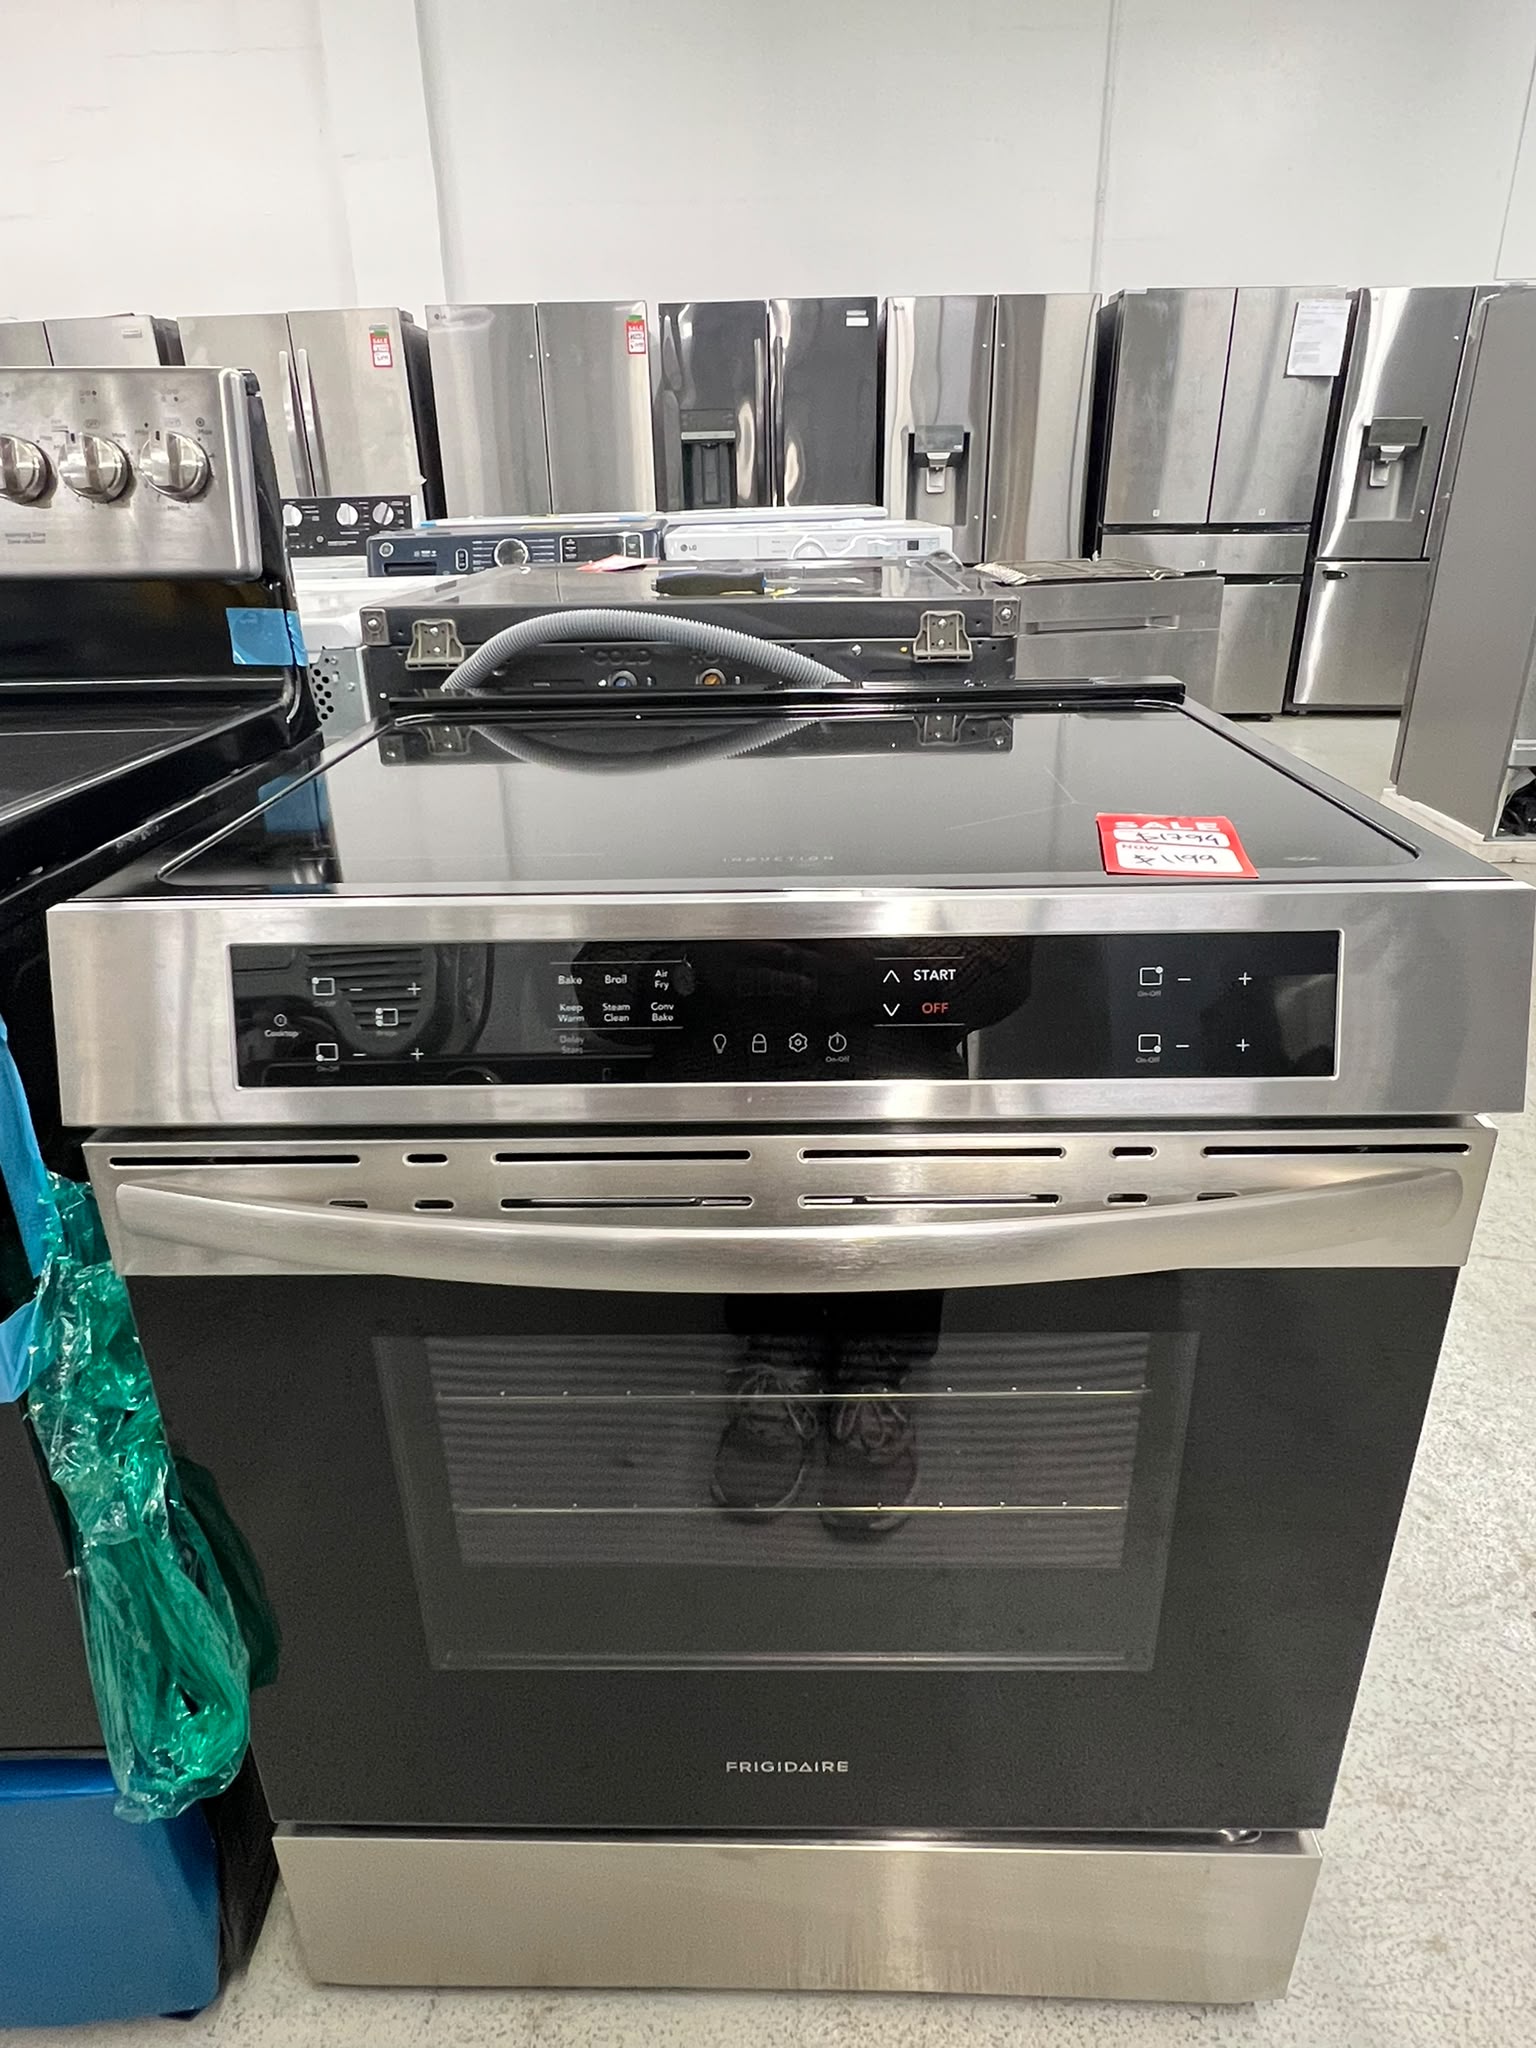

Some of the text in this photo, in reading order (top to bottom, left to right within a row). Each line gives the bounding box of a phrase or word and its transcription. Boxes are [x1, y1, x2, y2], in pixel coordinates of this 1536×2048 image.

[593, 650, 652, 665] COLD
[1114, 821, 1221, 832] SALE
[655, 969, 668, 978] Air
[913, 969, 956, 981] START
[558, 975, 582, 985] Bake
[604, 974, 627, 984] Broil
[654, 980, 669, 991] Fry
[560, 1003, 583, 1013] Keep
[602, 1003, 631, 1011] Steam
[650, 1002, 674, 1011] Conv
[922, 1002, 948, 1014] OFF
[557, 1014, 585, 1022] Warm
[603, 1013, 630, 1022] Clean
[651, 1013, 674, 1021] Bake
[725, 1760, 849, 1773] FRIGIDAIRE
